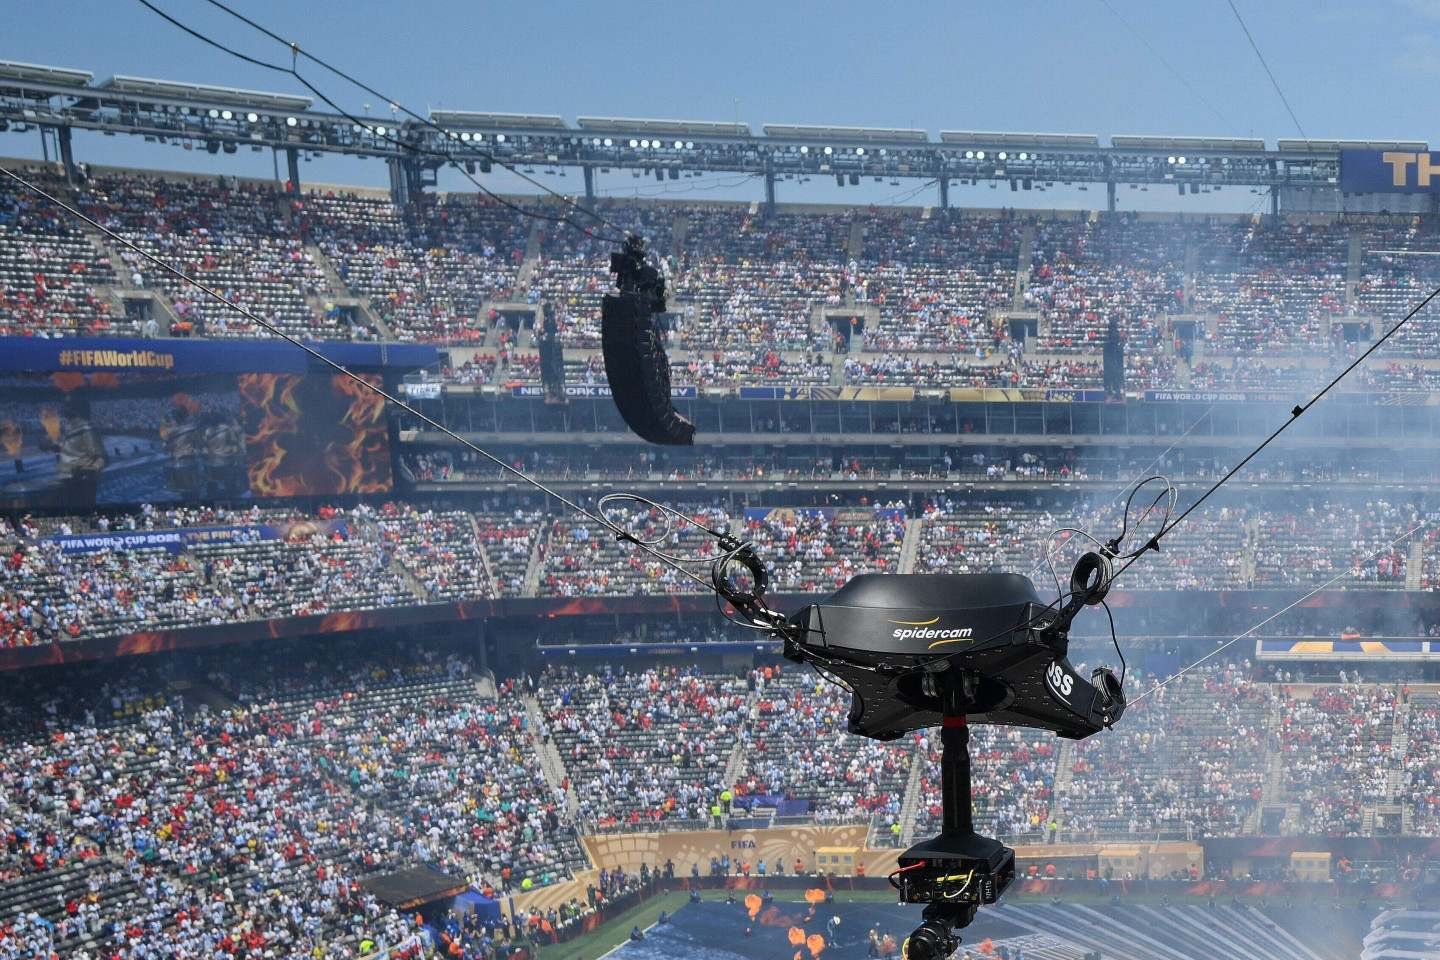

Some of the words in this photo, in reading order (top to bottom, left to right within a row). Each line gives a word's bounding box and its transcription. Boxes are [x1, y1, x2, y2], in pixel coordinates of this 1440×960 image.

[59, 350, 174, 368] #FIFAWorldCup
[60, 539, 85, 549] FIFA
[125, 535, 146, 545] CUP
[893, 627, 973, 641] spidercam
[731, 840, 756, 849] FIFA
